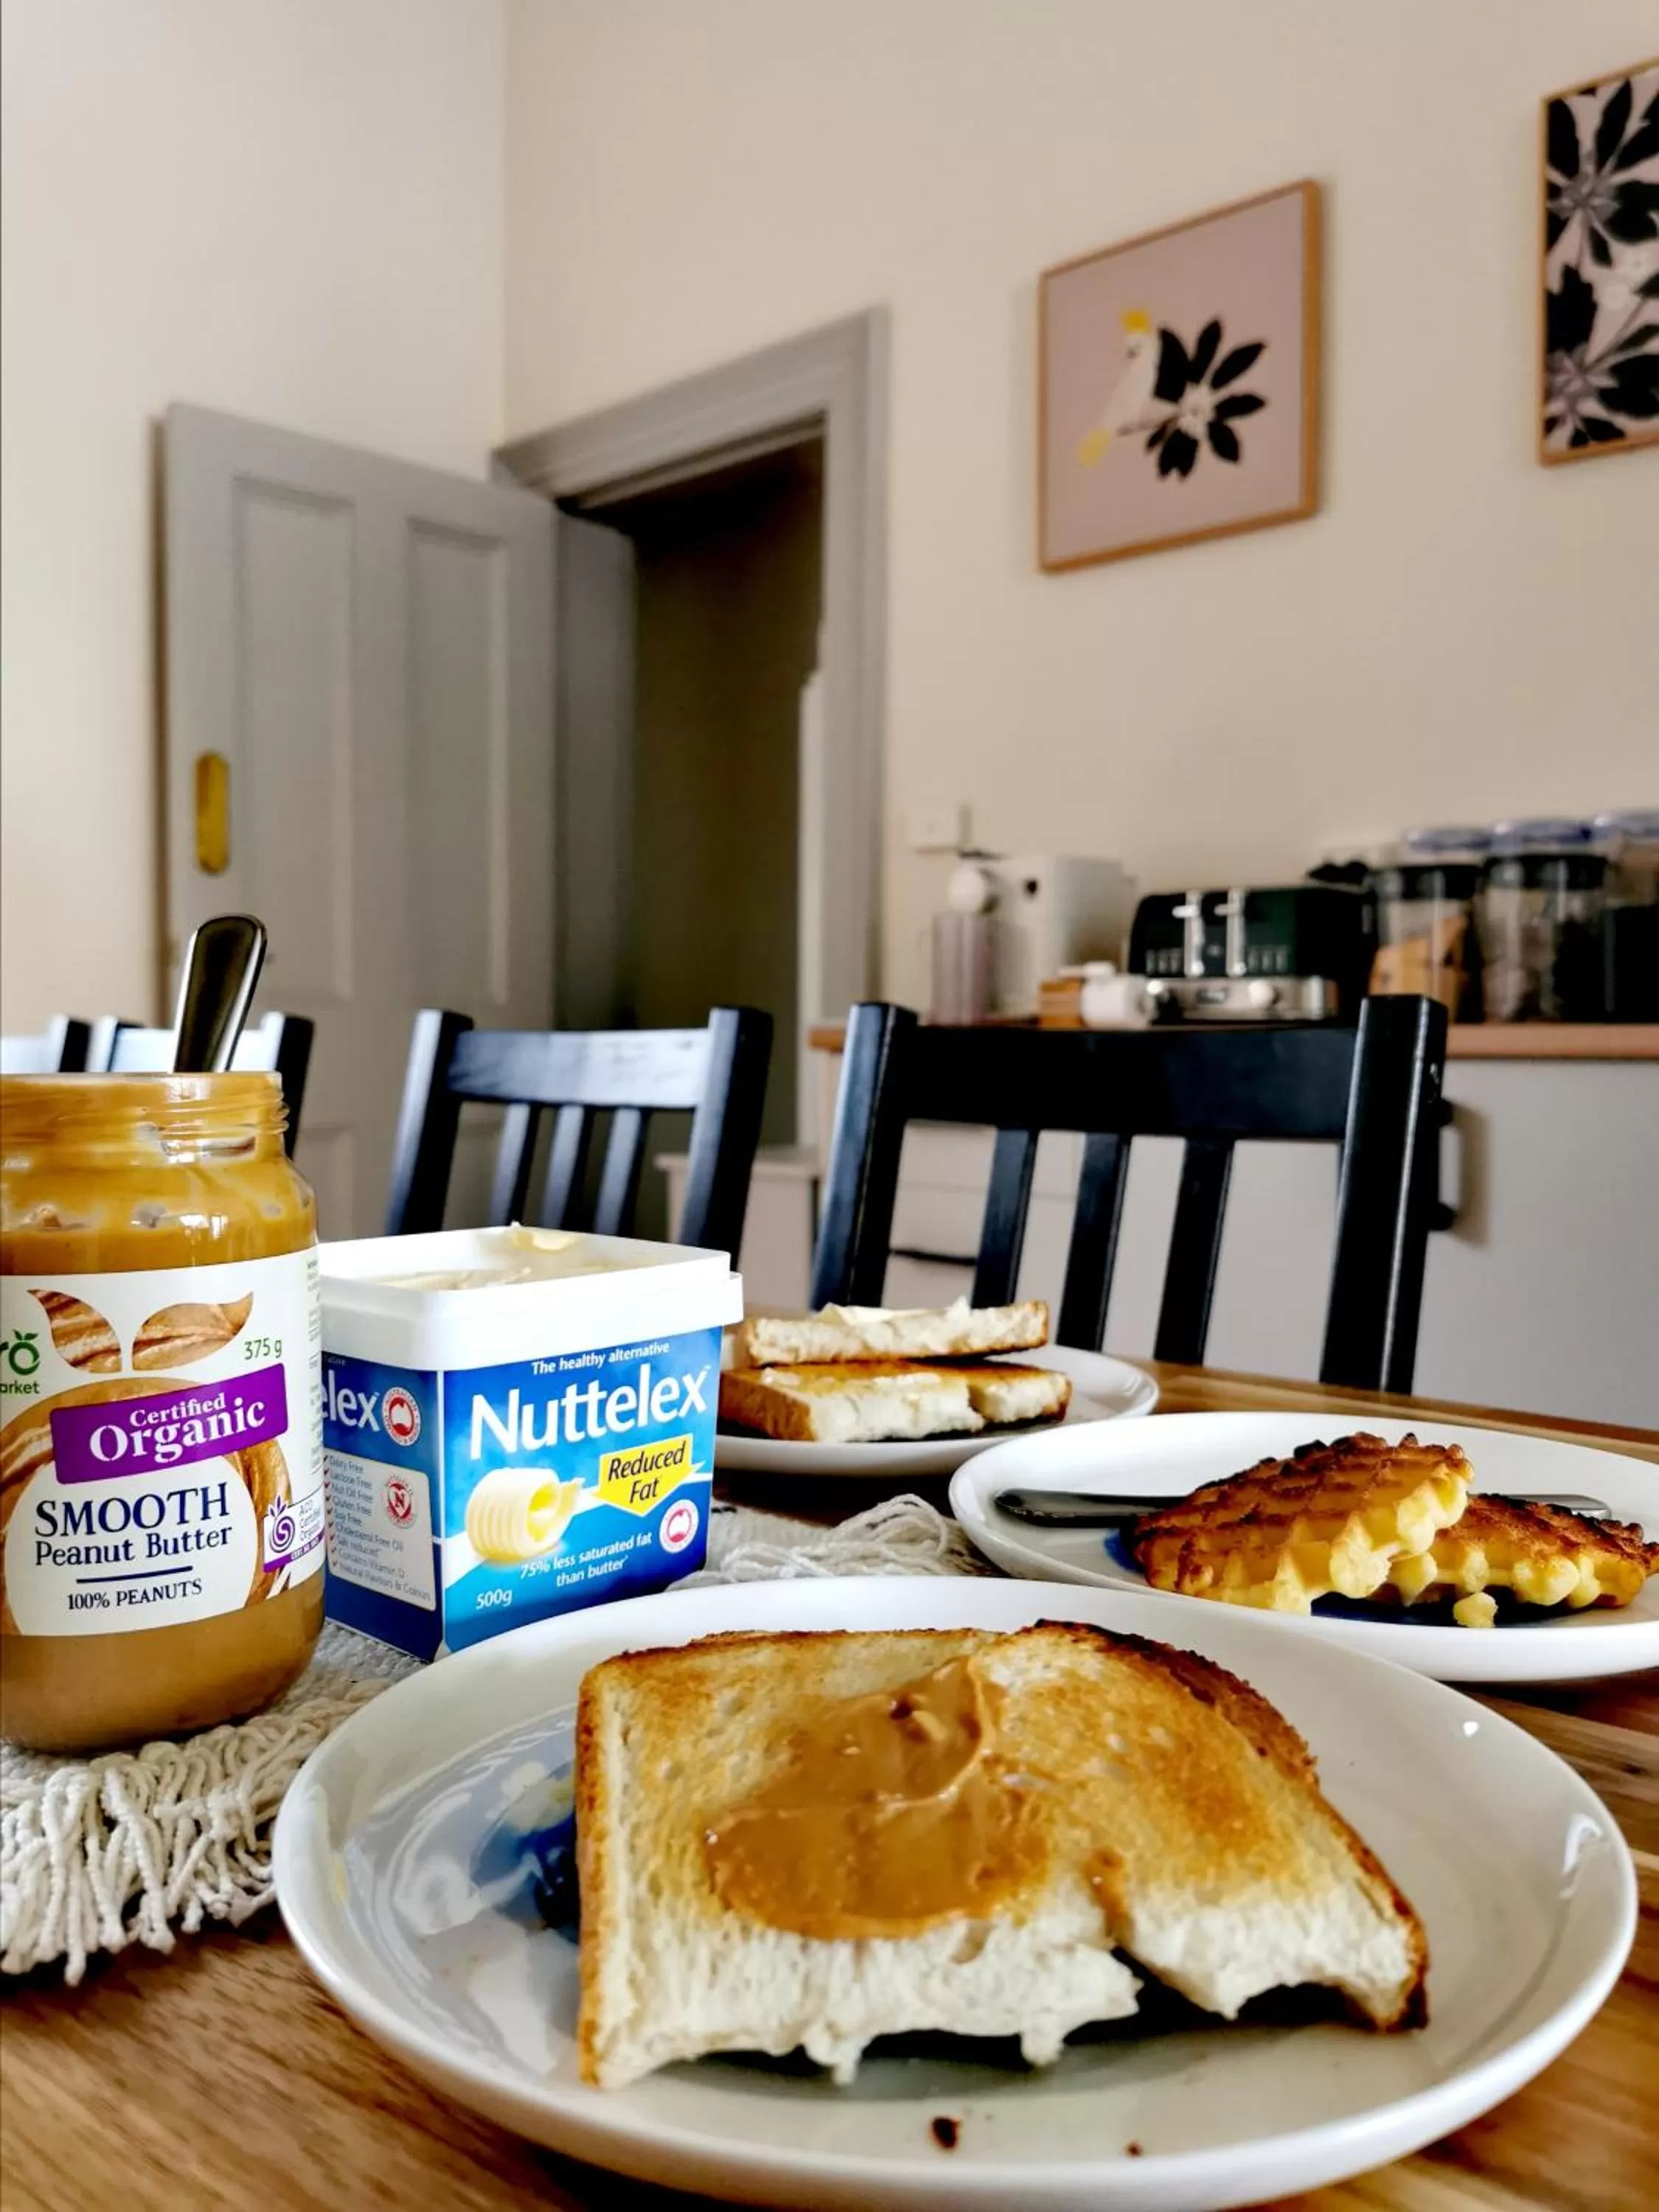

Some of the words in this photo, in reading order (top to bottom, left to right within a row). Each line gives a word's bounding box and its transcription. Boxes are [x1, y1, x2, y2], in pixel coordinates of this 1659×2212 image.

[244, 1337, 271, 1360] 375
[274, 1338, 282, 1359] g
[532, 1361, 555, 1375] The
[559, 1353, 605, 1371] healthy
[609, 1342, 669, 1363] alternative
[129, 1392, 226, 1427] Certified
[470, 1363, 709, 1461] Nuttelex
[89, 1397, 265, 1464] Organic
[608, 1441, 687, 1481] Reduced
[629, 1477, 659, 1504] Fat
[35, 1482, 230, 1537] SMOOTH
[35, 1539, 135, 1566] Peanut
[146, 1526, 232, 1558] Butter
[520, 1558, 549, 1579] 75%
[554, 1554, 576, 1570] less
[579, 1538, 633, 1563] saturated
[637, 1531, 653, 1548] fat
[68, 1591, 110, 1610] 100%
[116, 1578, 203, 1607] PEANUTS
[556, 1568, 584, 1587] than
[476, 1588, 512, 1610] 500g
